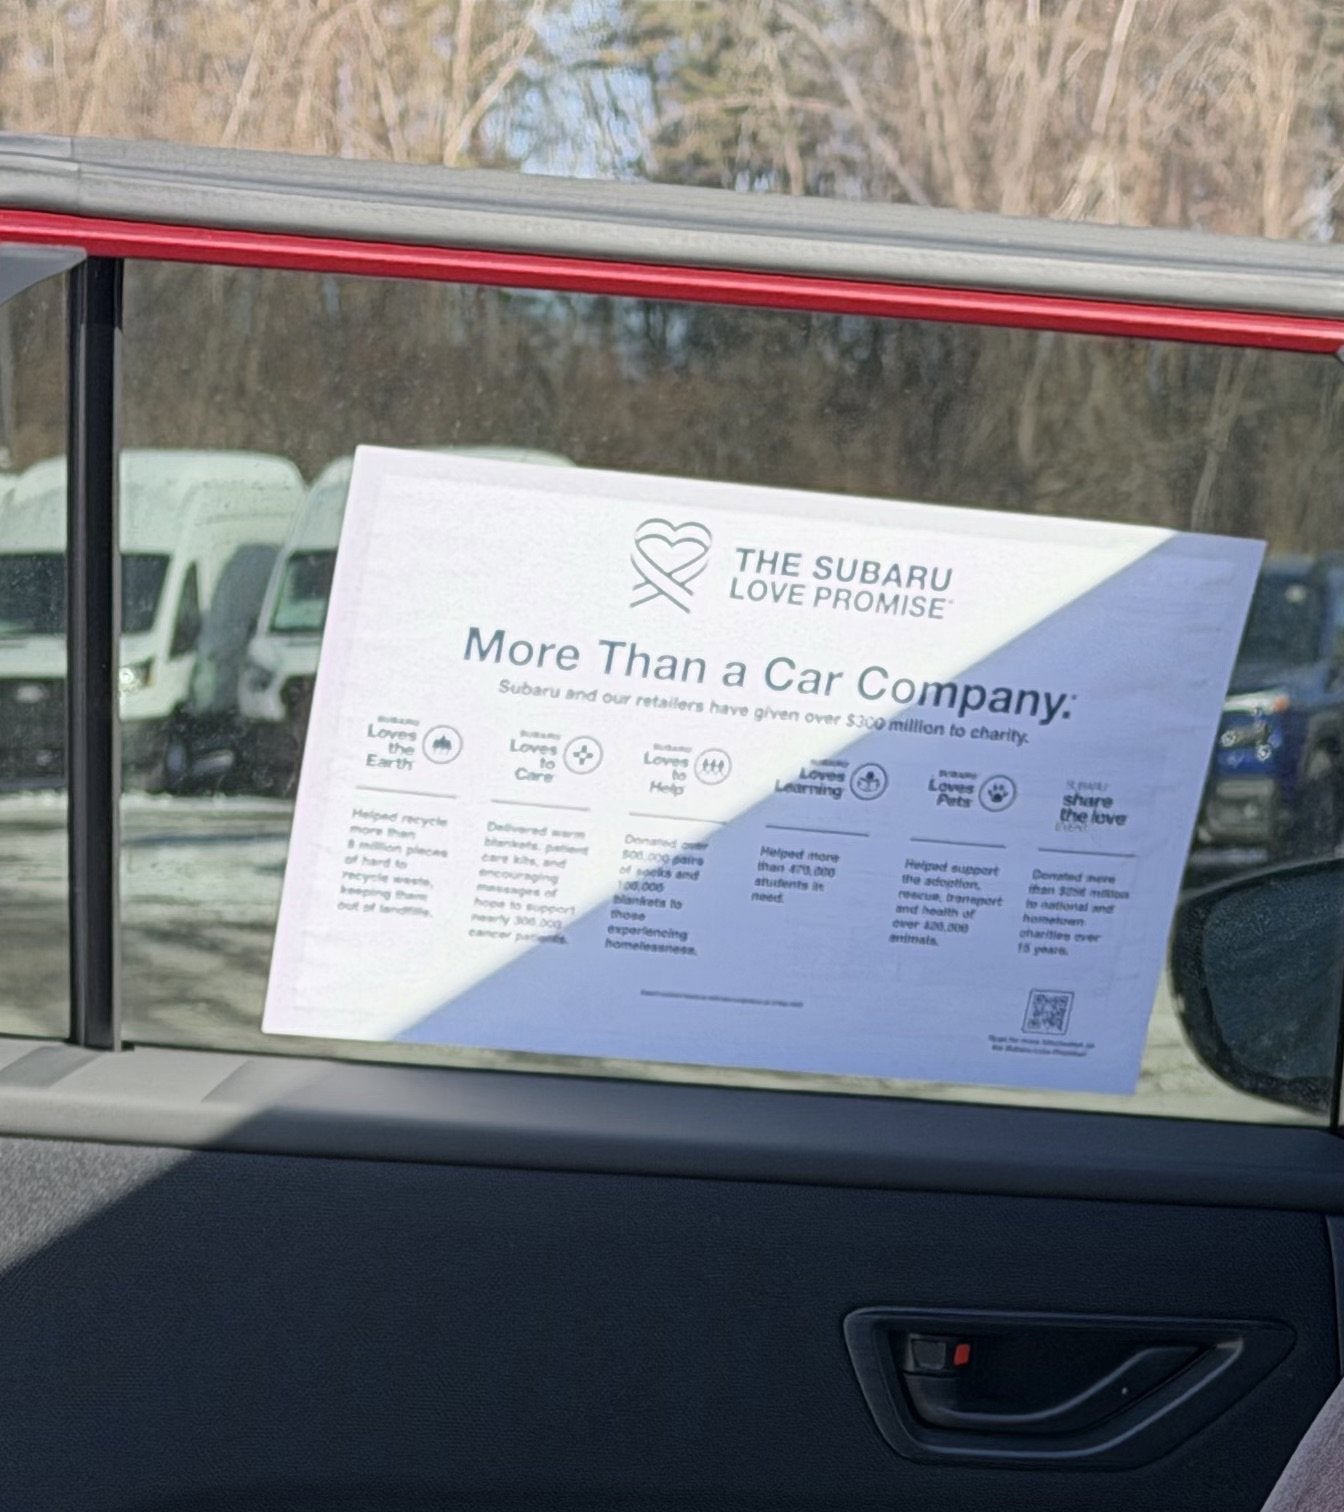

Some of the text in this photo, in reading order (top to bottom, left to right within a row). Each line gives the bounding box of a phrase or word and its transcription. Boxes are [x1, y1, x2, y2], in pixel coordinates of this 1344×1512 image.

[736, 547, 952, 591] THE SUBARU
[729, 577, 805, 605] LOVE
[464, 626, 580, 672] More
[598, 640, 706, 684] Than
[722, 660, 746, 687] a
[765, 656, 843, 696] Car
[499, 679, 560, 698] Subaru
[566, 688, 597, 702] and
[602, 692, 632, 704] our
[636, 695, 704, 712] retailers
[710, 700, 748, 716] have
[753, 708, 799, 722] given
[805, 712, 841, 726] over
[888, 720, 945, 736] million
[949, 724, 966, 737] to
[970, 727, 1029, 747] charity.
[368, 723, 416, 741] Loves
[388, 742, 415, 755] the
[510, 739, 557, 755] Loves
[366, 754, 413, 770] Earth
[540, 757, 555, 769] to
[644, 752, 688, 768] Loves
[515, 767, 553, 782] Care
[672, 770, 687, 781] to
[799, 767, 845, 782] Loves
[650, 781, 684, 797] Help
[775, 779, 844, 800] Learning
[928, 779, 975, 793] Loves
[937, 793, 971, 807] Pets
[1063, 792, 1113, 808] share
[1060, 808, 1128, 825] the love
[760, 846, 804, 860] Helped
